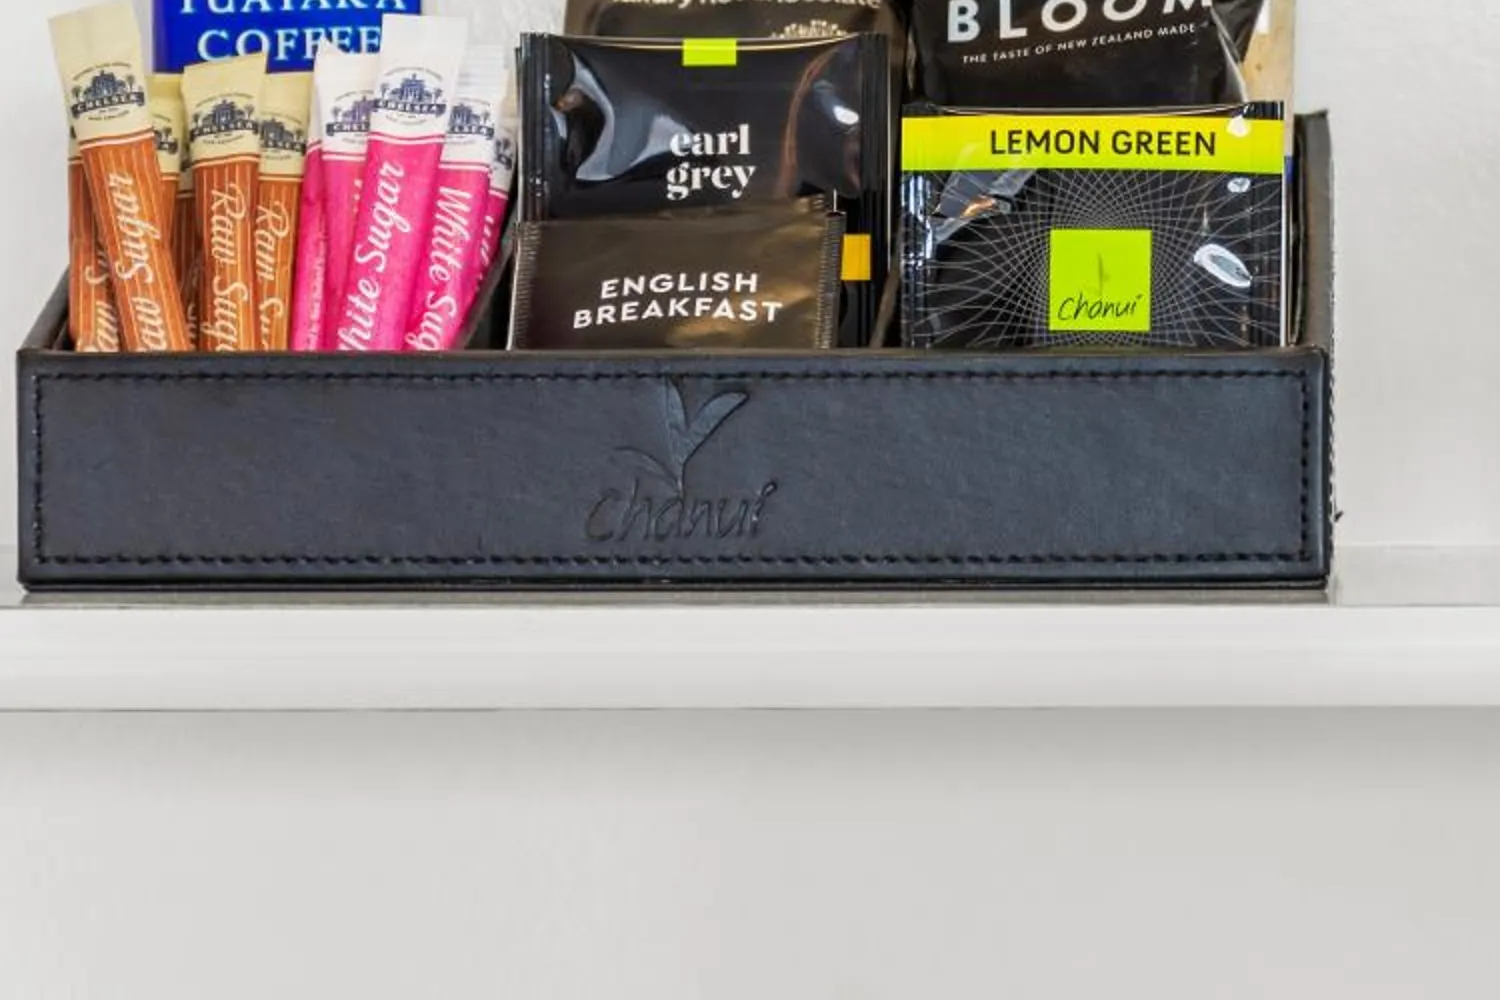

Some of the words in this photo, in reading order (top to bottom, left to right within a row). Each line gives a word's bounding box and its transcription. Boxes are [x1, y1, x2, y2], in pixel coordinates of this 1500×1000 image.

[963, 53, 987, 64] THE
[993, 48, 1029, 62] TASTE
[1035, 44, 1053, 55] OF
[1057, 39, 1087, 51] NEW
[1091, 29, 1153, 48] ZEALAND
[1157, 23, 1197, 37] MADE
[670, 124, 752, 157] earl
[989, 129, 1100, 156] LEMON
[1111, 130, 1217, 157] GREEN
[665, 161, 757, 201] grey
[108, 173, 160, 283] Sugar
[211, 182, 247, 266] Raw
[354, 161, 411, 273] Sugar
[427, 186, 472, 286] White
[200, 275, 249, 351] Sug
[573, 297, 784, 329] BREAKFAST
[600, 272, 758, 301] ENGLISH
[1057, 294, 1143, 322] Chanui
[136, 296, 168, 351] aw
[337, 279, 381, 351] hite
[405, 291, 457, 351] Sug
